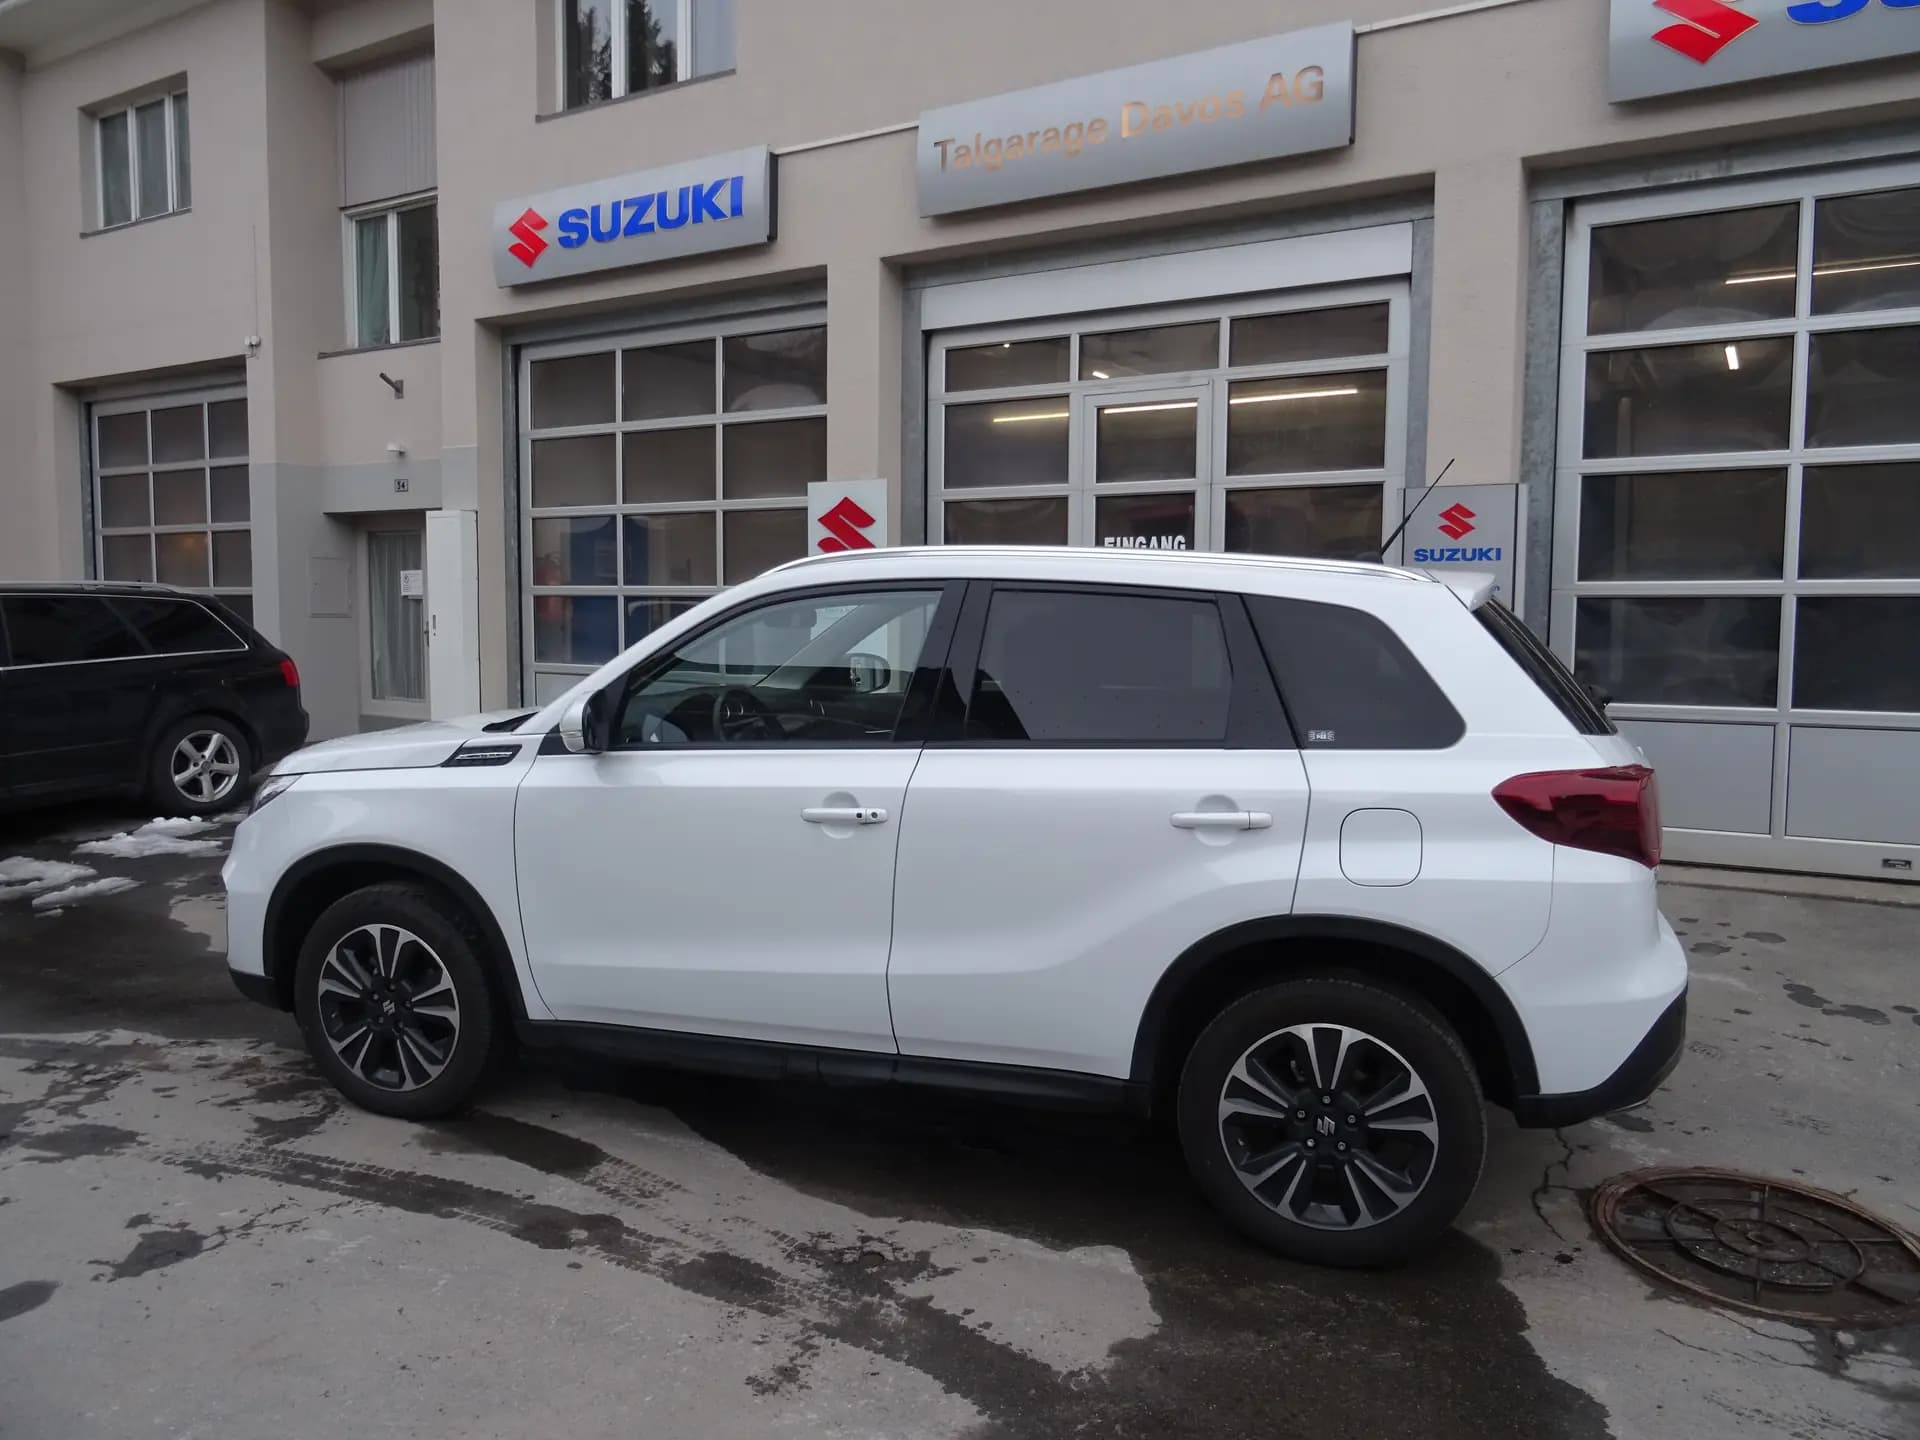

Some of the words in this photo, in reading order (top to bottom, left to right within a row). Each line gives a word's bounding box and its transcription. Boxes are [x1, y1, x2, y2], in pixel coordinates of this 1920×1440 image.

[933, 115, 1108, 173] Talgarage
[1120, 89, 1248, 139] Davos
[1260, 65, 1324, 113] AG
[557, 175, 744, 249] SUZUKI
[1104, 534, 1186, 550] EINGANG
[1413, 547, 1502, 562] SUZUKI
